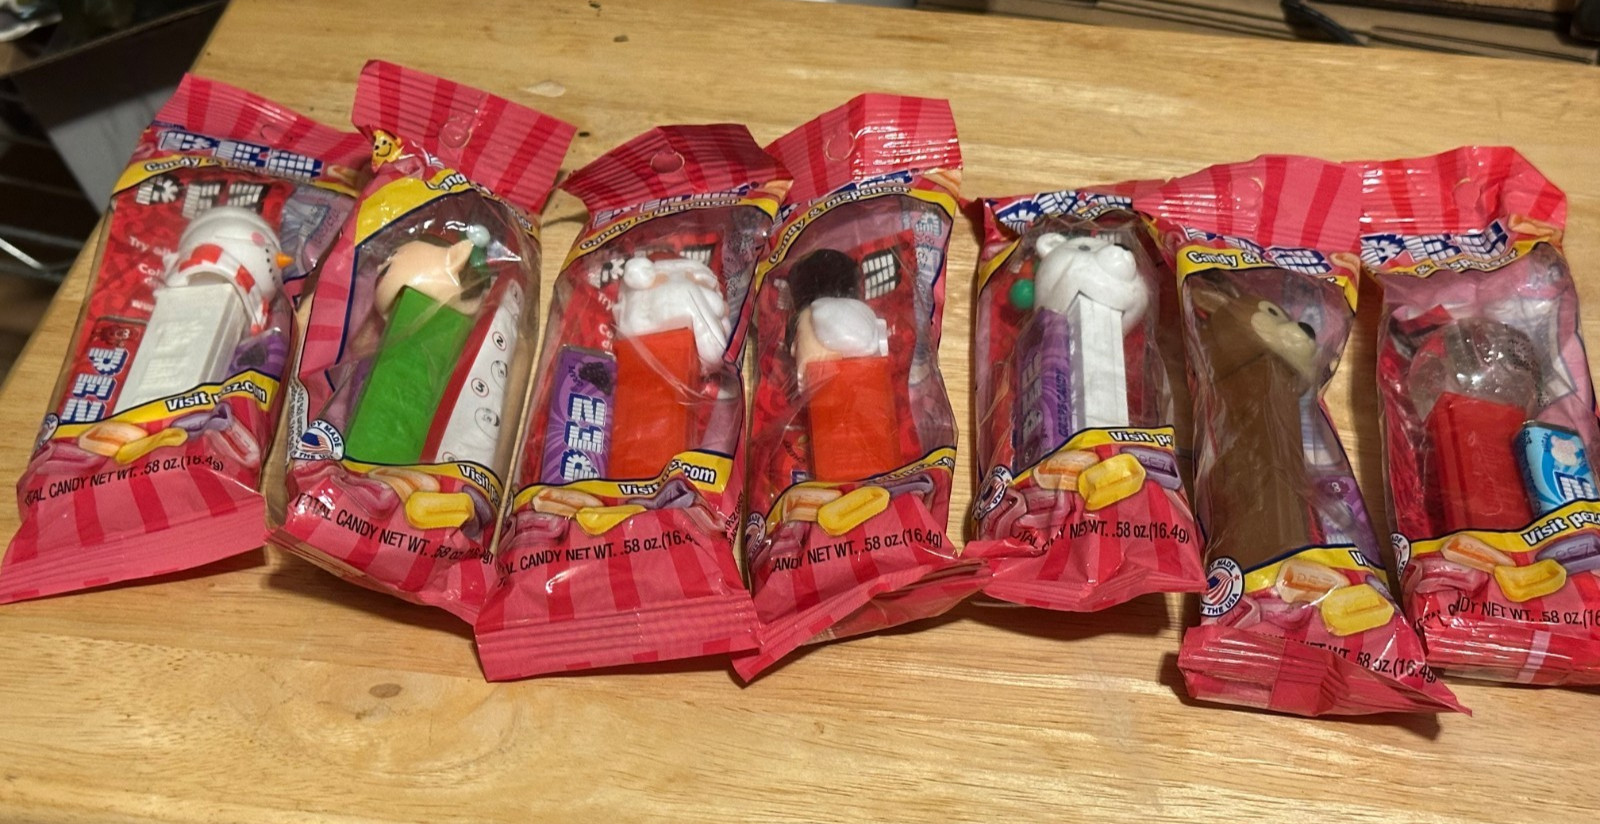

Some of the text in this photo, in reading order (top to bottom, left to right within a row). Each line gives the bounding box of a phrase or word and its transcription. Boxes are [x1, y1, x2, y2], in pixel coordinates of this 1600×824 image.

[144, 156, 202, 173] Candy
[159, 129, 324, 180] PEZ
[580, 221, 631, 251] Candy
[1360, 220, 1509, 266] PEZ
[1187, 250, 1239, 267] Candy
[59, 346, 130, 424] PEZ
[165, 391, 212, 412] Visit
[324, 424, 342, 448] MADE
[560, 392, 607, 482] PEZ
[1108, 431, 1155, 442] Visit
[49, 476, 89, 498] CANDY
[90, 470, 116, 487] NET
[116, 466, 138, 480] WT.
[140, 459, 160, 475] .58
[618, 481, 661, 495] Visit
[336, 509, 379, 540] CANDY
[378, 528, 407, 548] NET
[407, 534, 430, 556] WT.
[1111, 521, 1131, 538] .58
[1521, 518, 1569, 547] Visit
[519, 550, 562, 571] CANDY
[565, 547, 592, 561] NET
[593, 543, 617, 559] WT.
[620, 538, 640, 555] .58
[807, 545, 832, 564] NET
[833, 540, 858, 558] WT.
[861, 536, 881, 554] .58
[1217, 559, 1236, 571] MADE
[1207, 593, 1240, 615] THE USA
[1481, 602, 1507, 618] NET
[1509, 607, 1535, 622] WT.
[1538, 610, 1560, 624] .58
